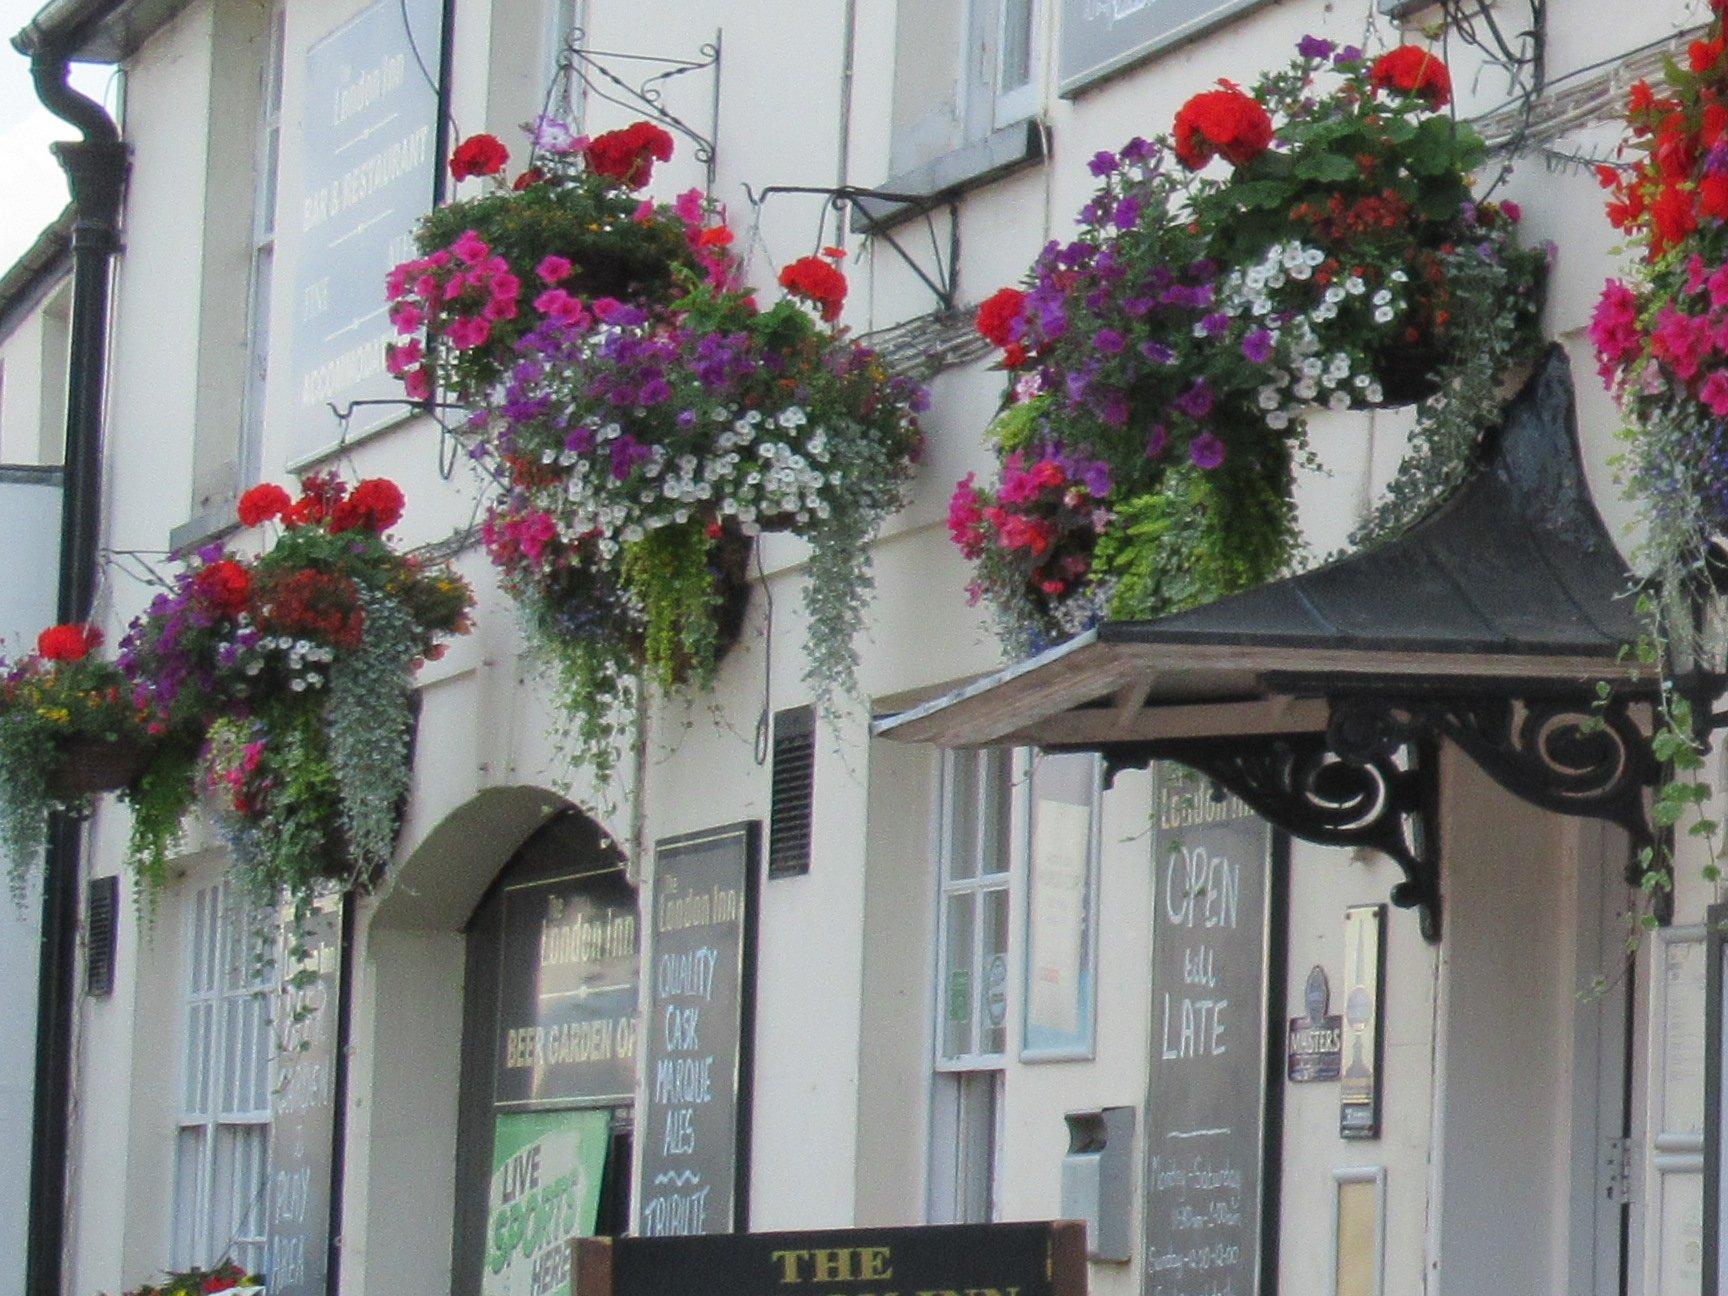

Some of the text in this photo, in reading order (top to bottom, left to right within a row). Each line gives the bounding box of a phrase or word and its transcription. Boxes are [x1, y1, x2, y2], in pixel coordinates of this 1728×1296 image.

[660, 887, 710, 933] London
[1166, 845, 1241, 929] OPEN
[541, 907, 635, 966] London Inn
[506, 1026, 545, 1068] BEER
[547, 1018, 613, 1064] GARDEN
[664, 1003, 700, 1051] CASK
[1162, 992, 1229, 1061] LATE
[655, 1055, 714, 1105] MARQUE
[502, 1143, 542, 1204] LIVE
[772, 1246, 893, 1285] THE
